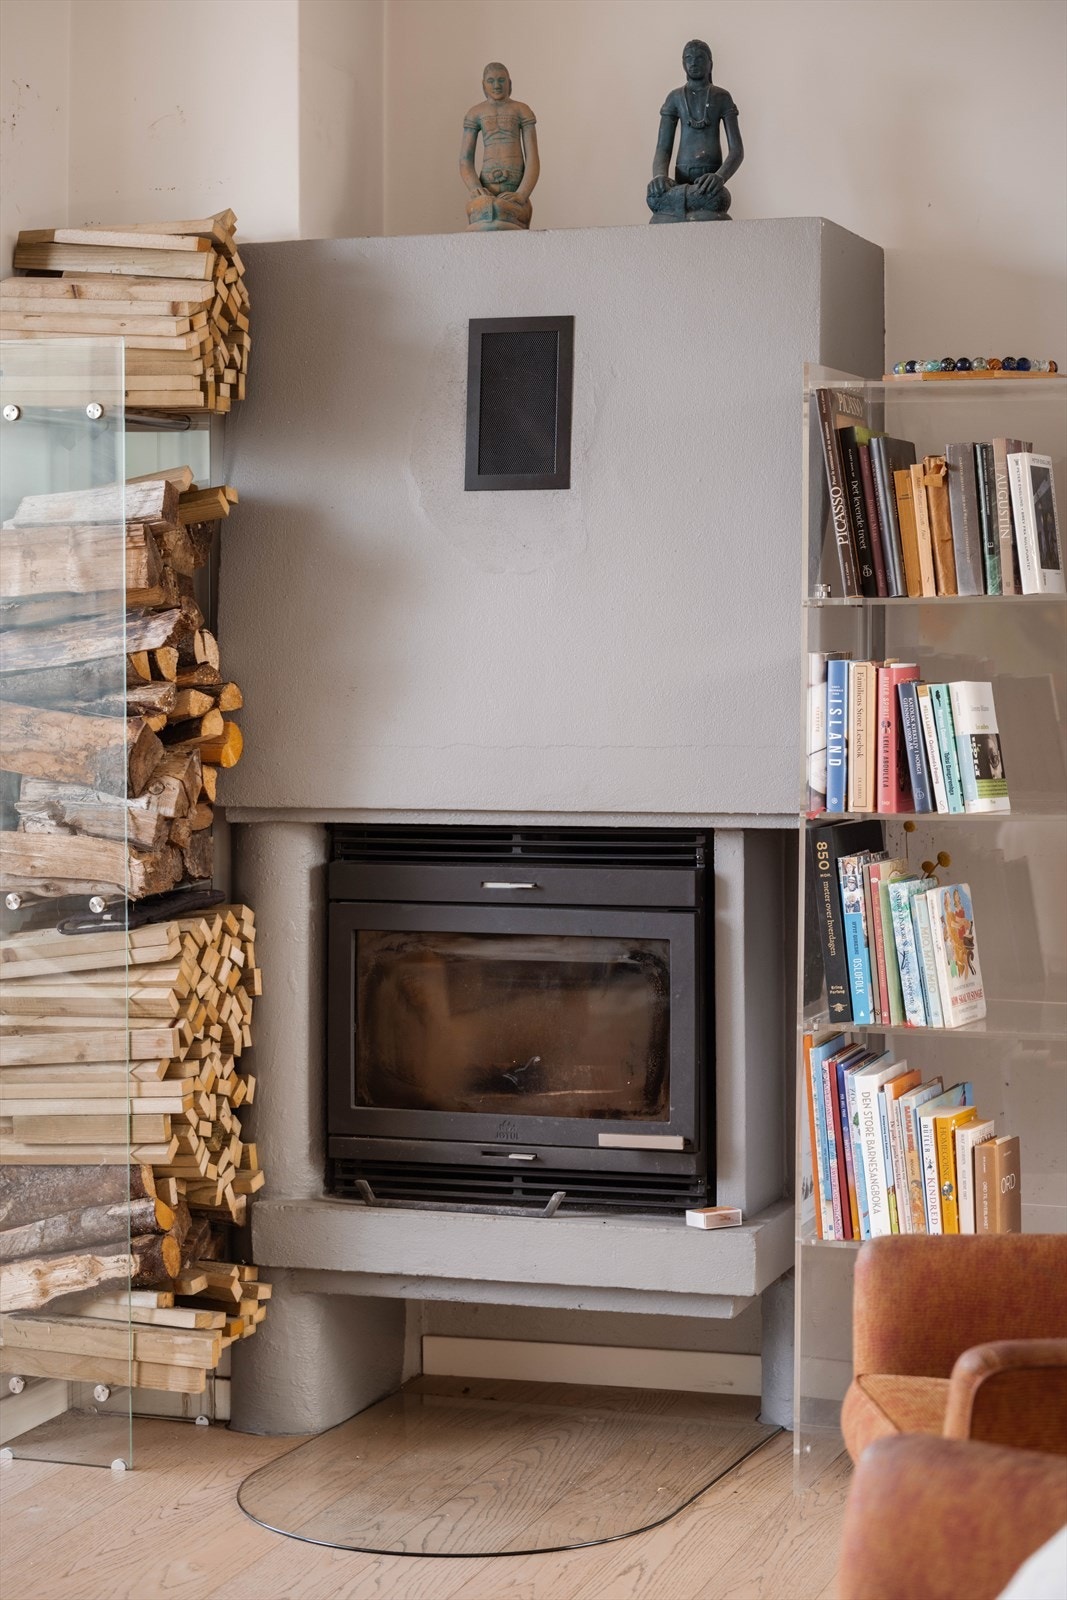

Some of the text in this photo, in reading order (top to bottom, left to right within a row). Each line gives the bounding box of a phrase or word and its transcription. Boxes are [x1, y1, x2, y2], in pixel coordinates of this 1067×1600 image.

[838, 392, 863, 418] PICASSO
[829, 486, 849, 545] PICASSO
[850, 480, 867, 549] Det levende treet
[996, 473, 1010, 538] AUGUSTIN
[828, 699, 841, 765] ISLAND
[902, 697, 911, 726] GJENNOM
[907, 697, 916, 721] KATOLSK
[913, 753, 921, 774] NORGE
[816, 840, 829, 870] 850
[822, 880, 838, 956] meter over hverdagen
[851, 957, 865, 994] OSLOFOLK
[849, 1087, 857, 1105] ZOG
[861, 1091, 883, 1214] DEN STORE BARNESANGBOKA
[921, 1123, 931, 1152] BUTLER
[939, 1126, 950, 1179] HOMEGOING
[926, 1177, 939, 1225] KINDRED
[1000, 1172, 1016, 1195] ORD
